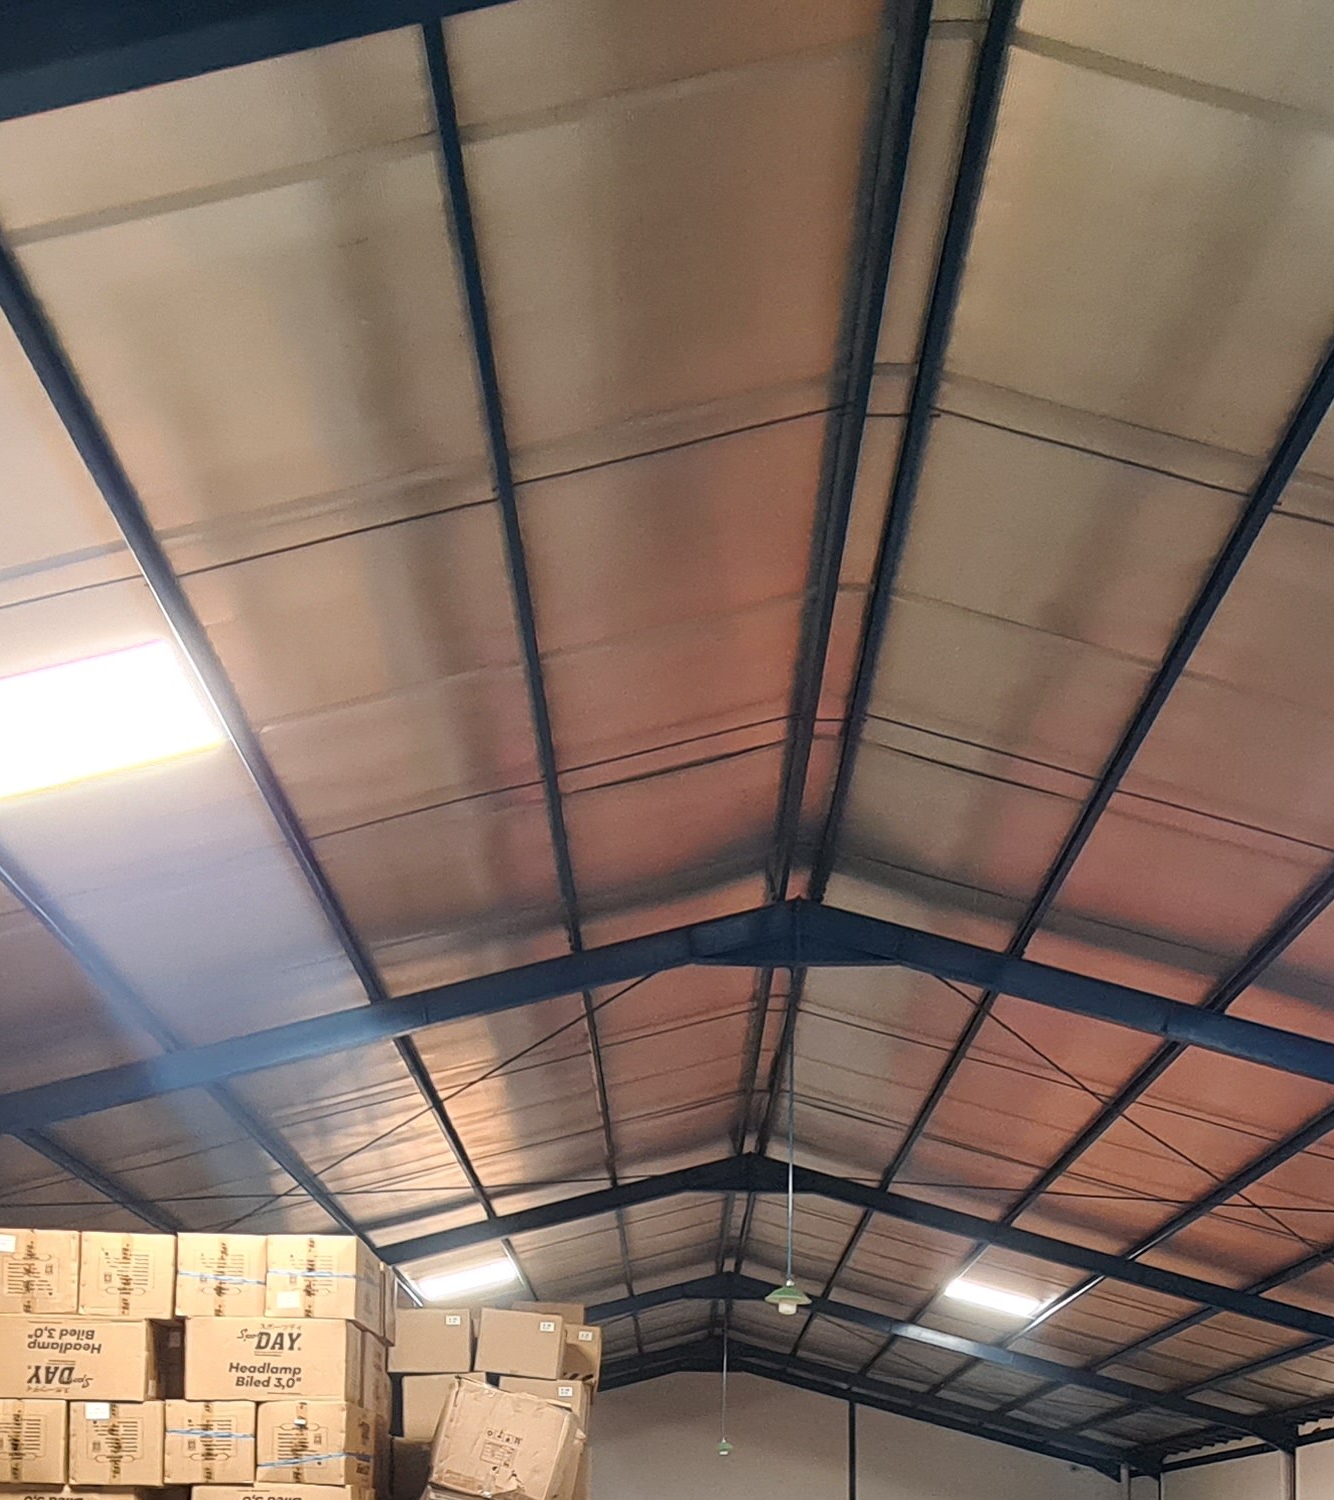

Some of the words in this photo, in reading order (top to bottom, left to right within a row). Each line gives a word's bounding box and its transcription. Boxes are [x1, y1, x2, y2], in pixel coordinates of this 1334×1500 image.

[59, 1328, 96, 1341] Biled
[27, 1338, 102, 1354] Headlamp
[228, 1362, 302, 1377] Headlamp
[235, 1375, 270, 1388] Biled
